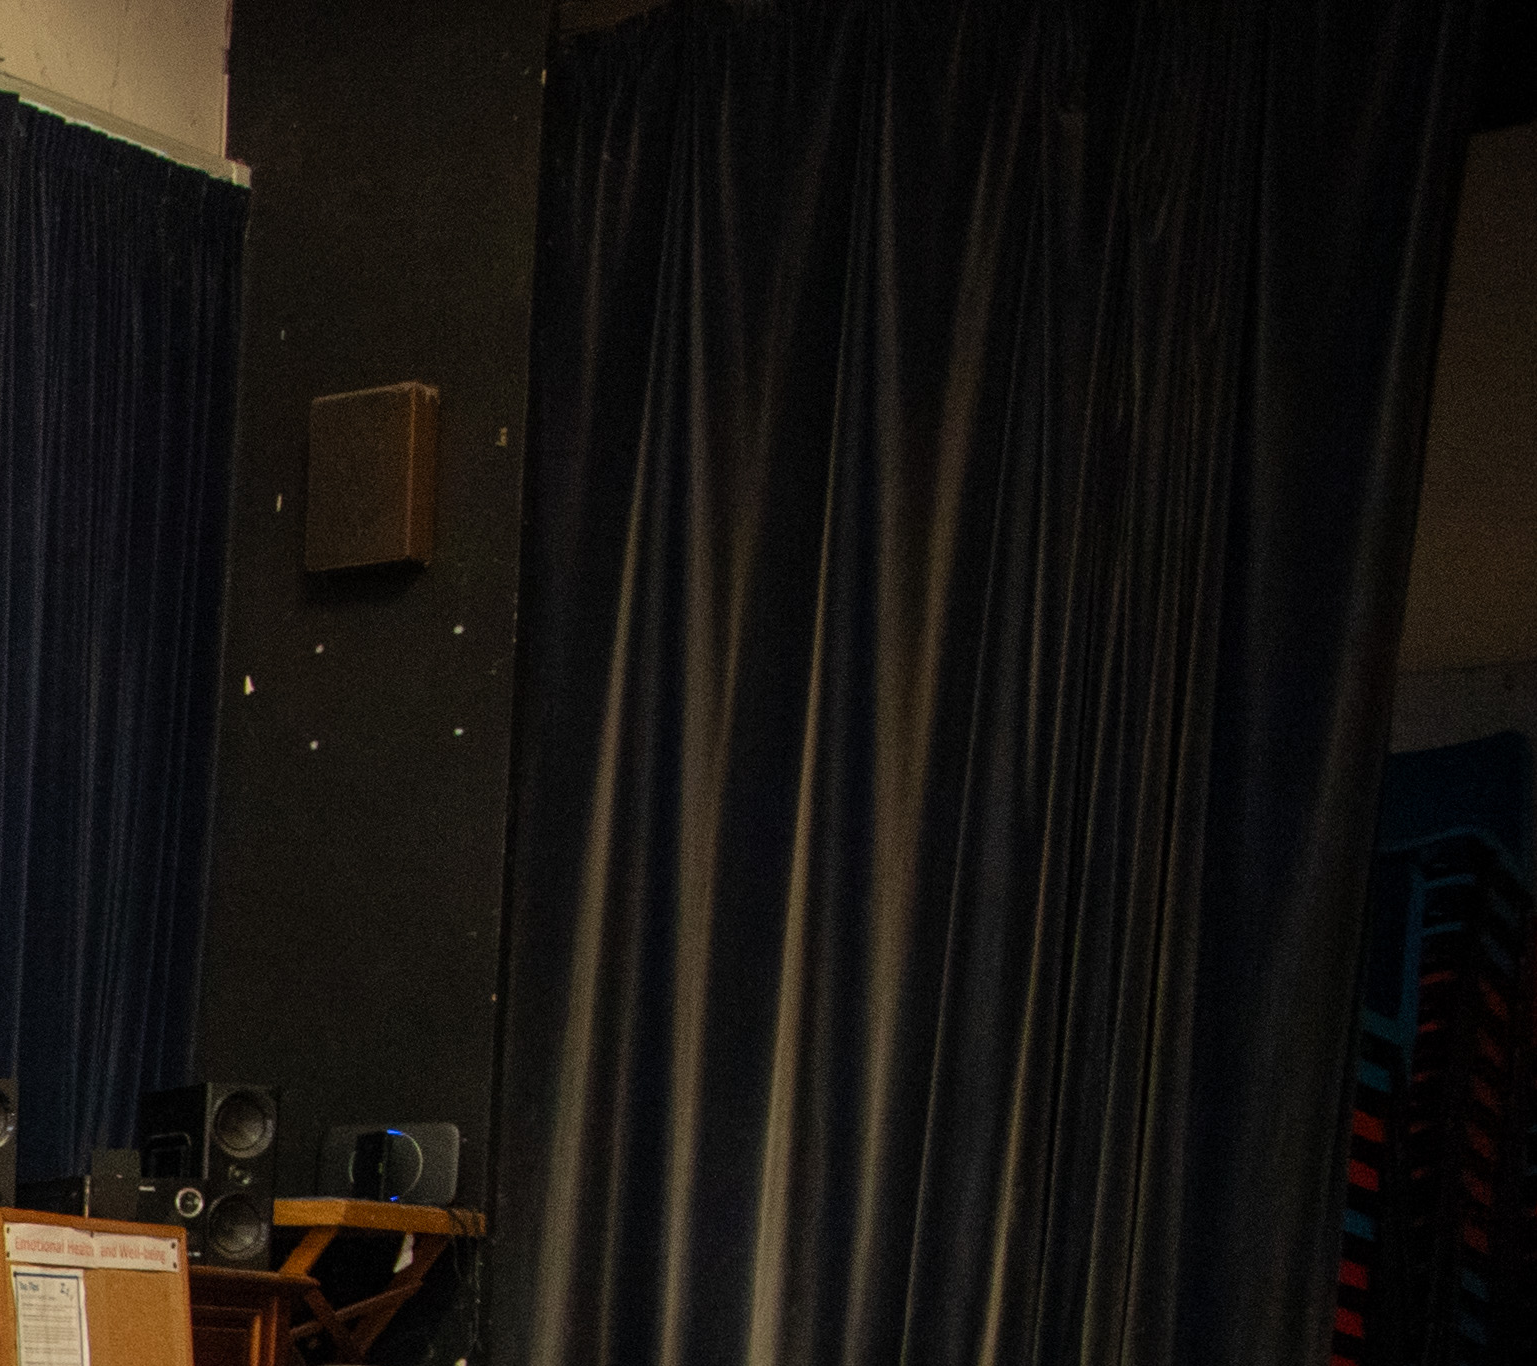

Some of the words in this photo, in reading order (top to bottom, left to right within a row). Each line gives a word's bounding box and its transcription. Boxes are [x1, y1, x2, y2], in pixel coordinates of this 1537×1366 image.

[15, 1238, 64, 1254] Emotional
[67, 1241, 94, 1258] Health
[101, 1246, 116, 1258] and
[119, 1245, 167, 1264] Well-being
